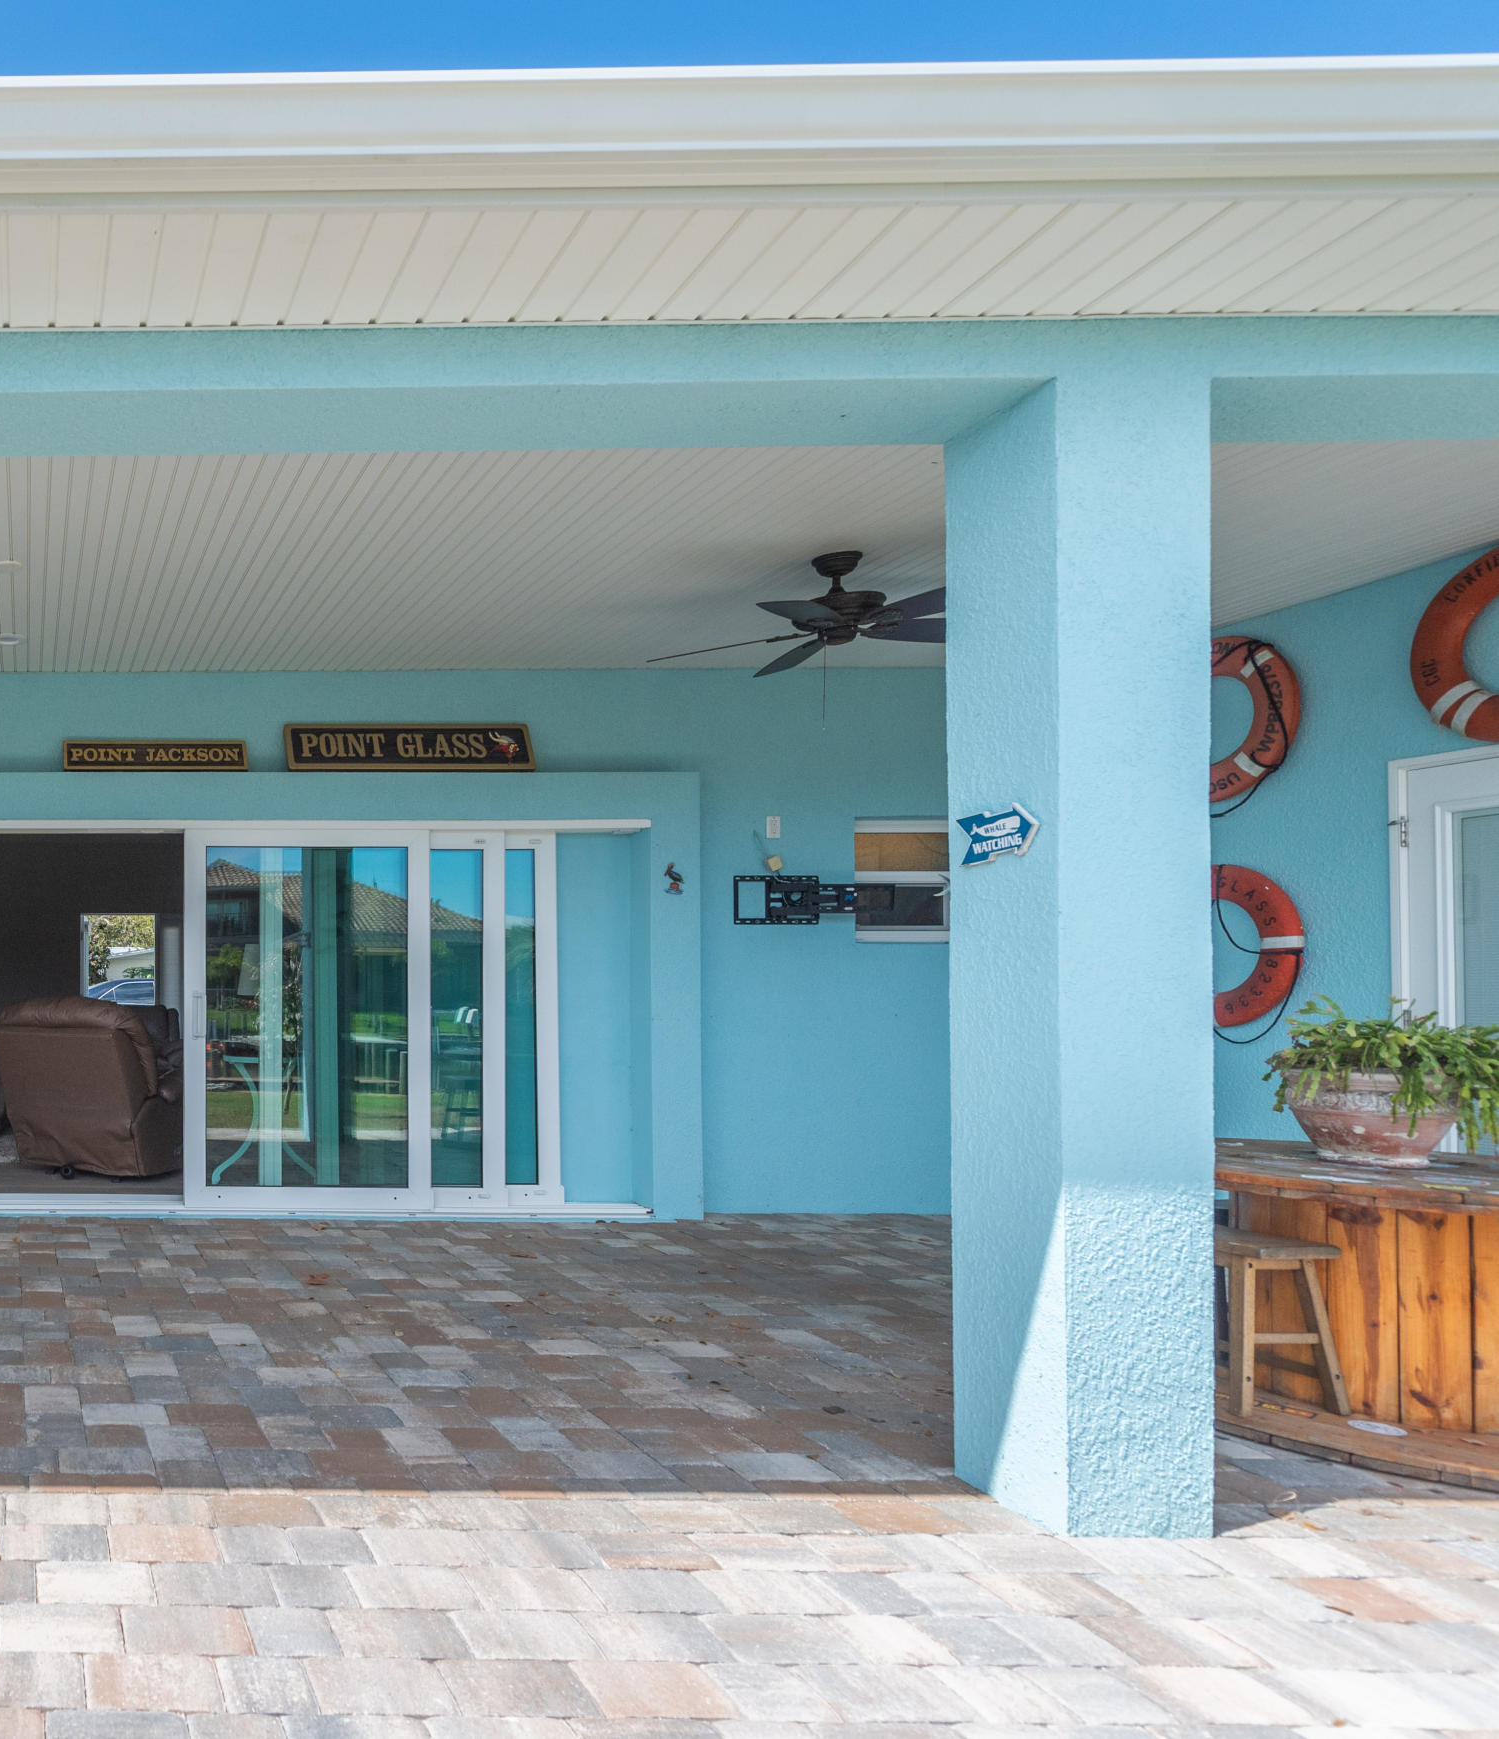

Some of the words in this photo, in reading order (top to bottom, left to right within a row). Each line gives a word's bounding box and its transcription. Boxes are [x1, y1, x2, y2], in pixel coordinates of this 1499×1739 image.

[70, 748, 137, 762] POINT
[145, 748, 240, 762] JACKSON
[299, 733, 386, 758] POINT
[396, 732, 488, 759] GLASS
[983, 822, 1007, 835] WHALE
[971, 832, 1023, 855] WATCHING
[1217, 876, 1277, 927] GLASS
